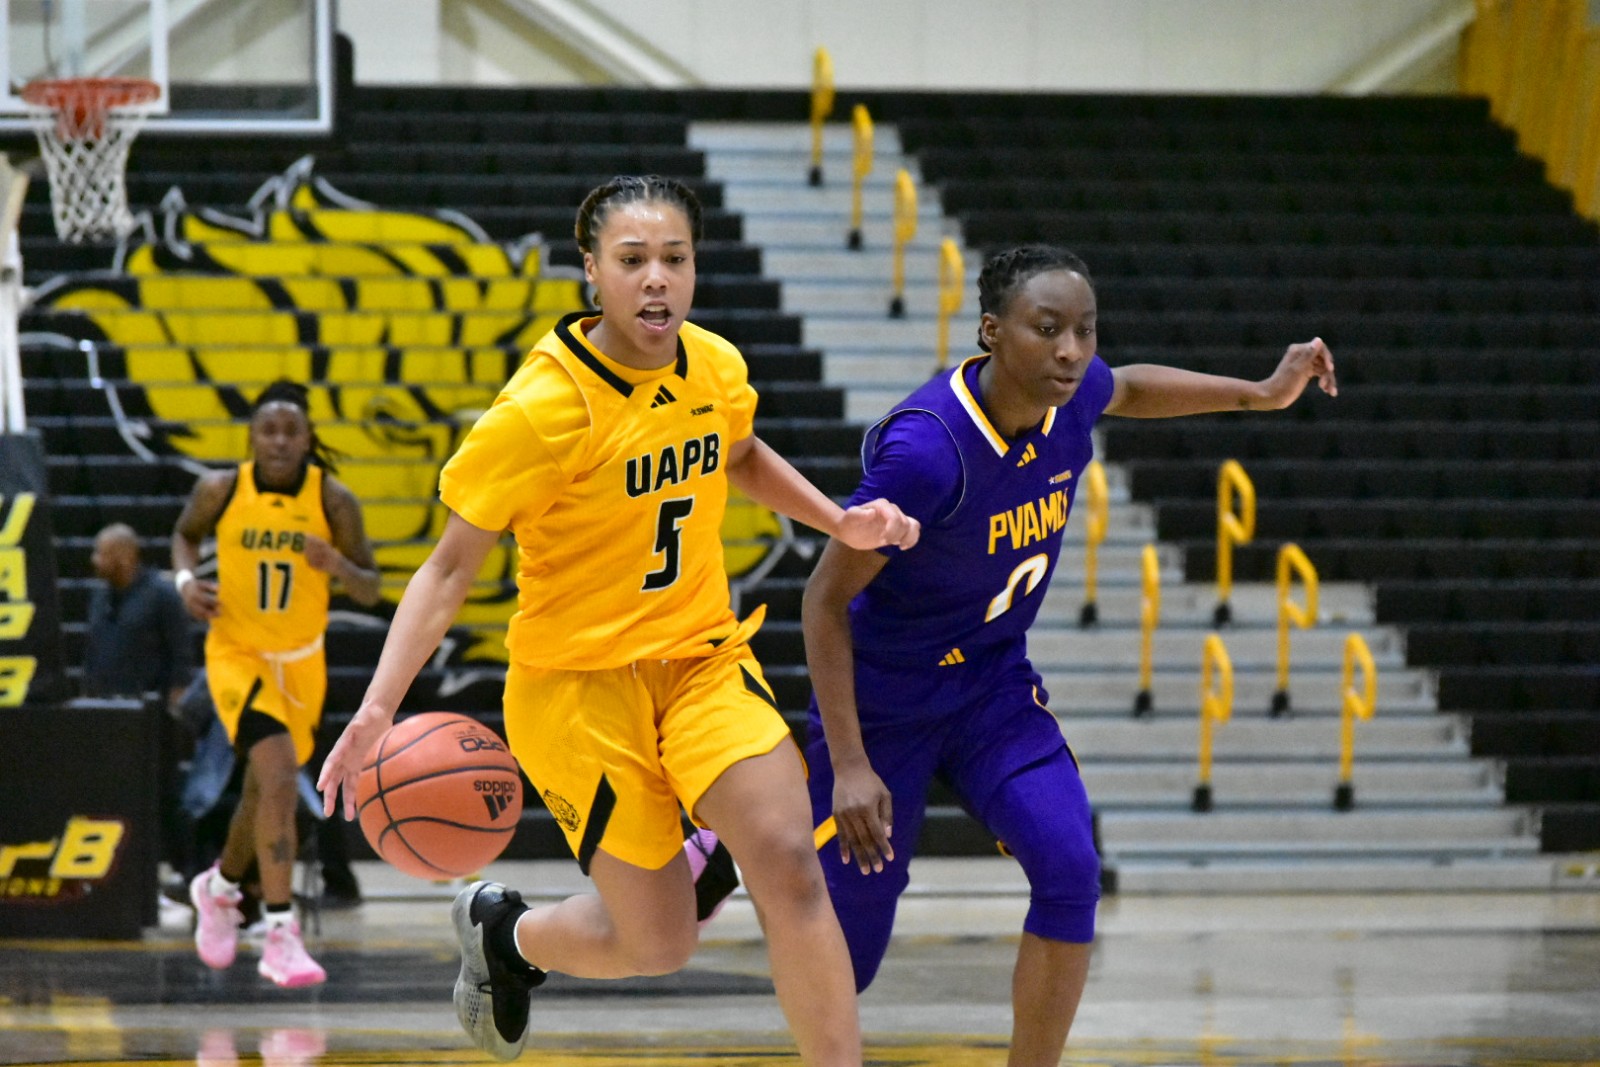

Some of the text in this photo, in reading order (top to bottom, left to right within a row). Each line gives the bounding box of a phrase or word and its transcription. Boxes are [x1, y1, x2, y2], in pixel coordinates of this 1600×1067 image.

[625, 432, 719, 498] UAPB
[241, 528, 305, 553] UAPB
[639, 494, 695, 594] 5
[258, 560, 293, 611] 17
[473, 780, 516, 796] adidas
